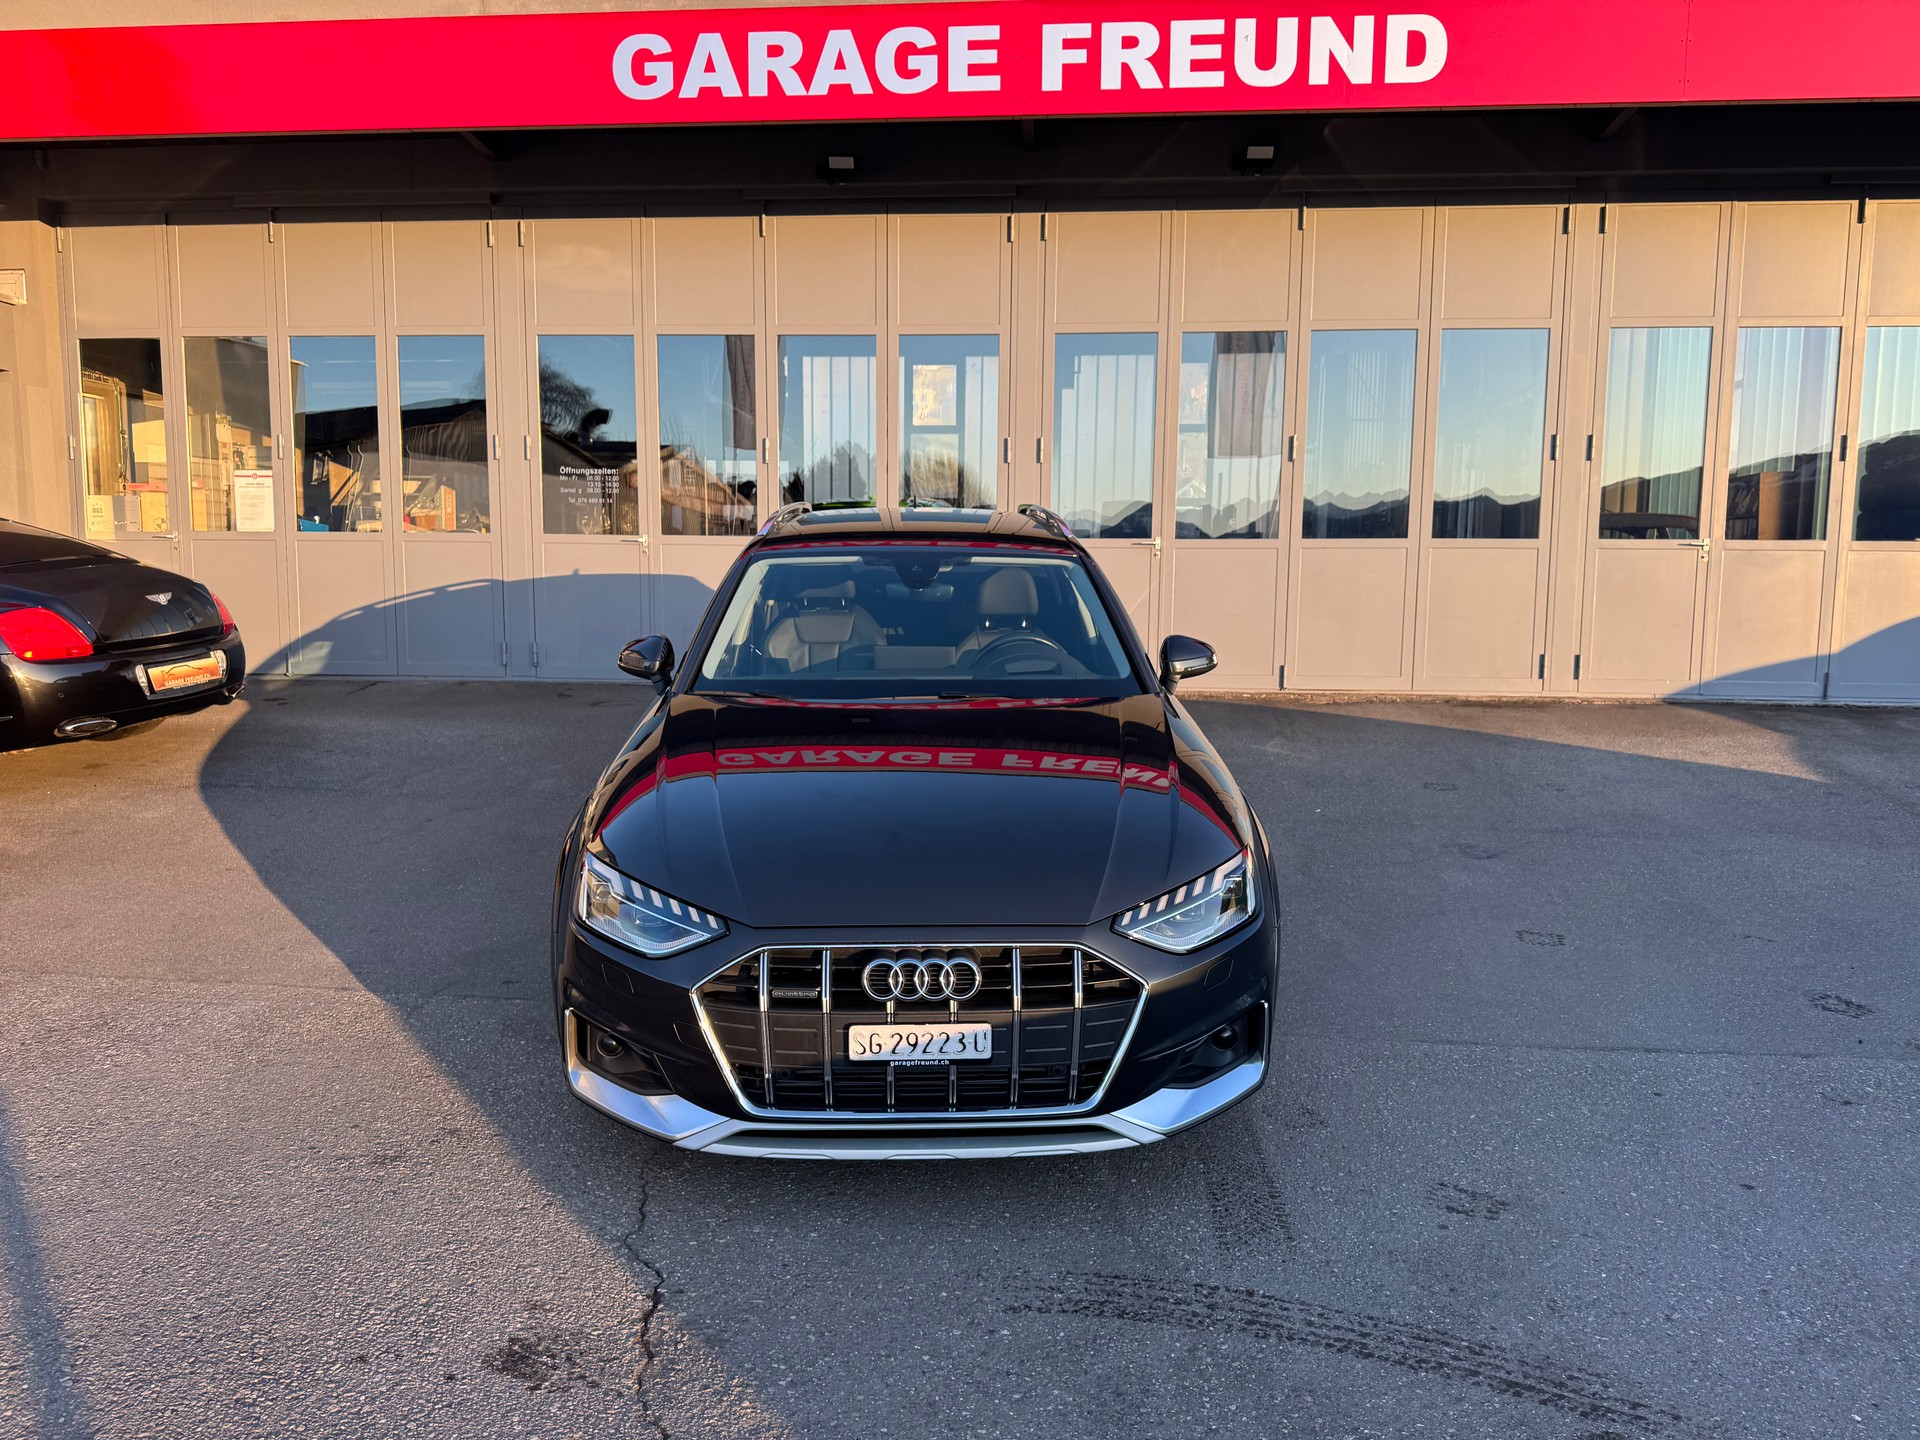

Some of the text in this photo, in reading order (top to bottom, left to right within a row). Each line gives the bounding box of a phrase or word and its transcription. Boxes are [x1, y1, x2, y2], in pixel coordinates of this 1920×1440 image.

[612, 13, 1449, 100] GARAGE FREUND
[560, 466, 619, 475] Öffnungszeiten:
